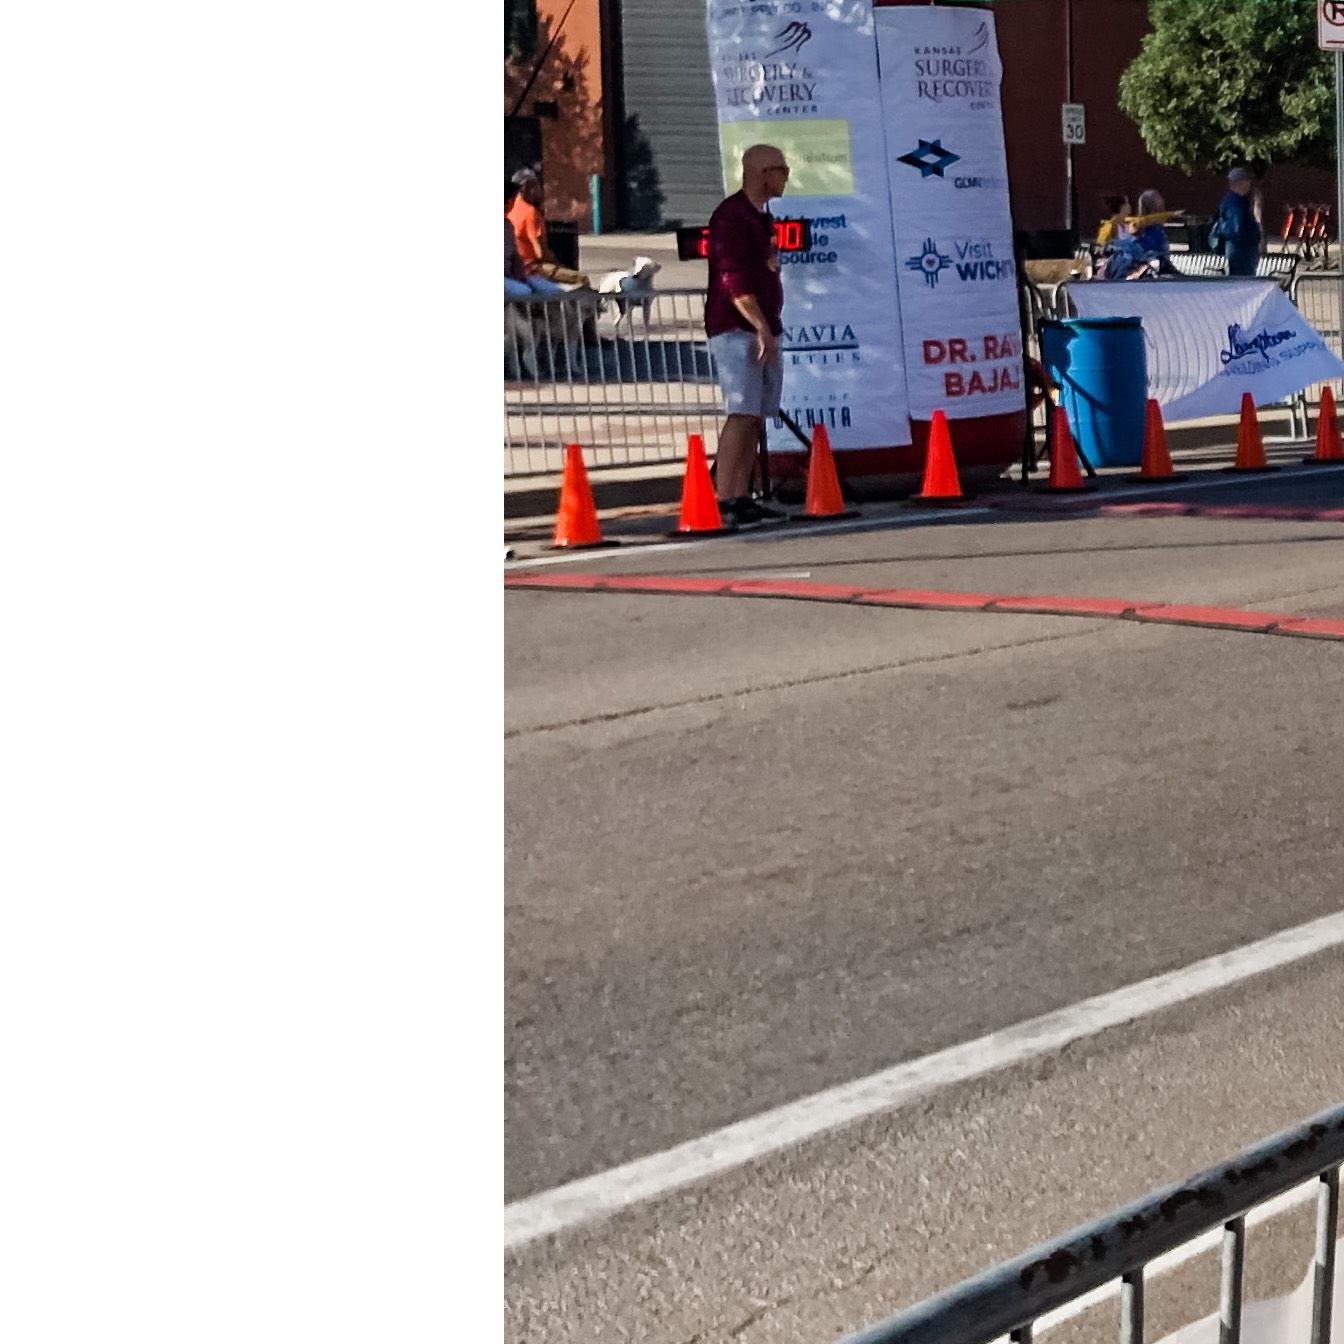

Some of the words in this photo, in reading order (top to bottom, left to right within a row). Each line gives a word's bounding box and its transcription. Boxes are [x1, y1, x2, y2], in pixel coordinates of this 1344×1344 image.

[1067, 124, 1083, 139] 30
[954, 241, 993, 259] Visit
[923, 338, 976, 365] DR.
